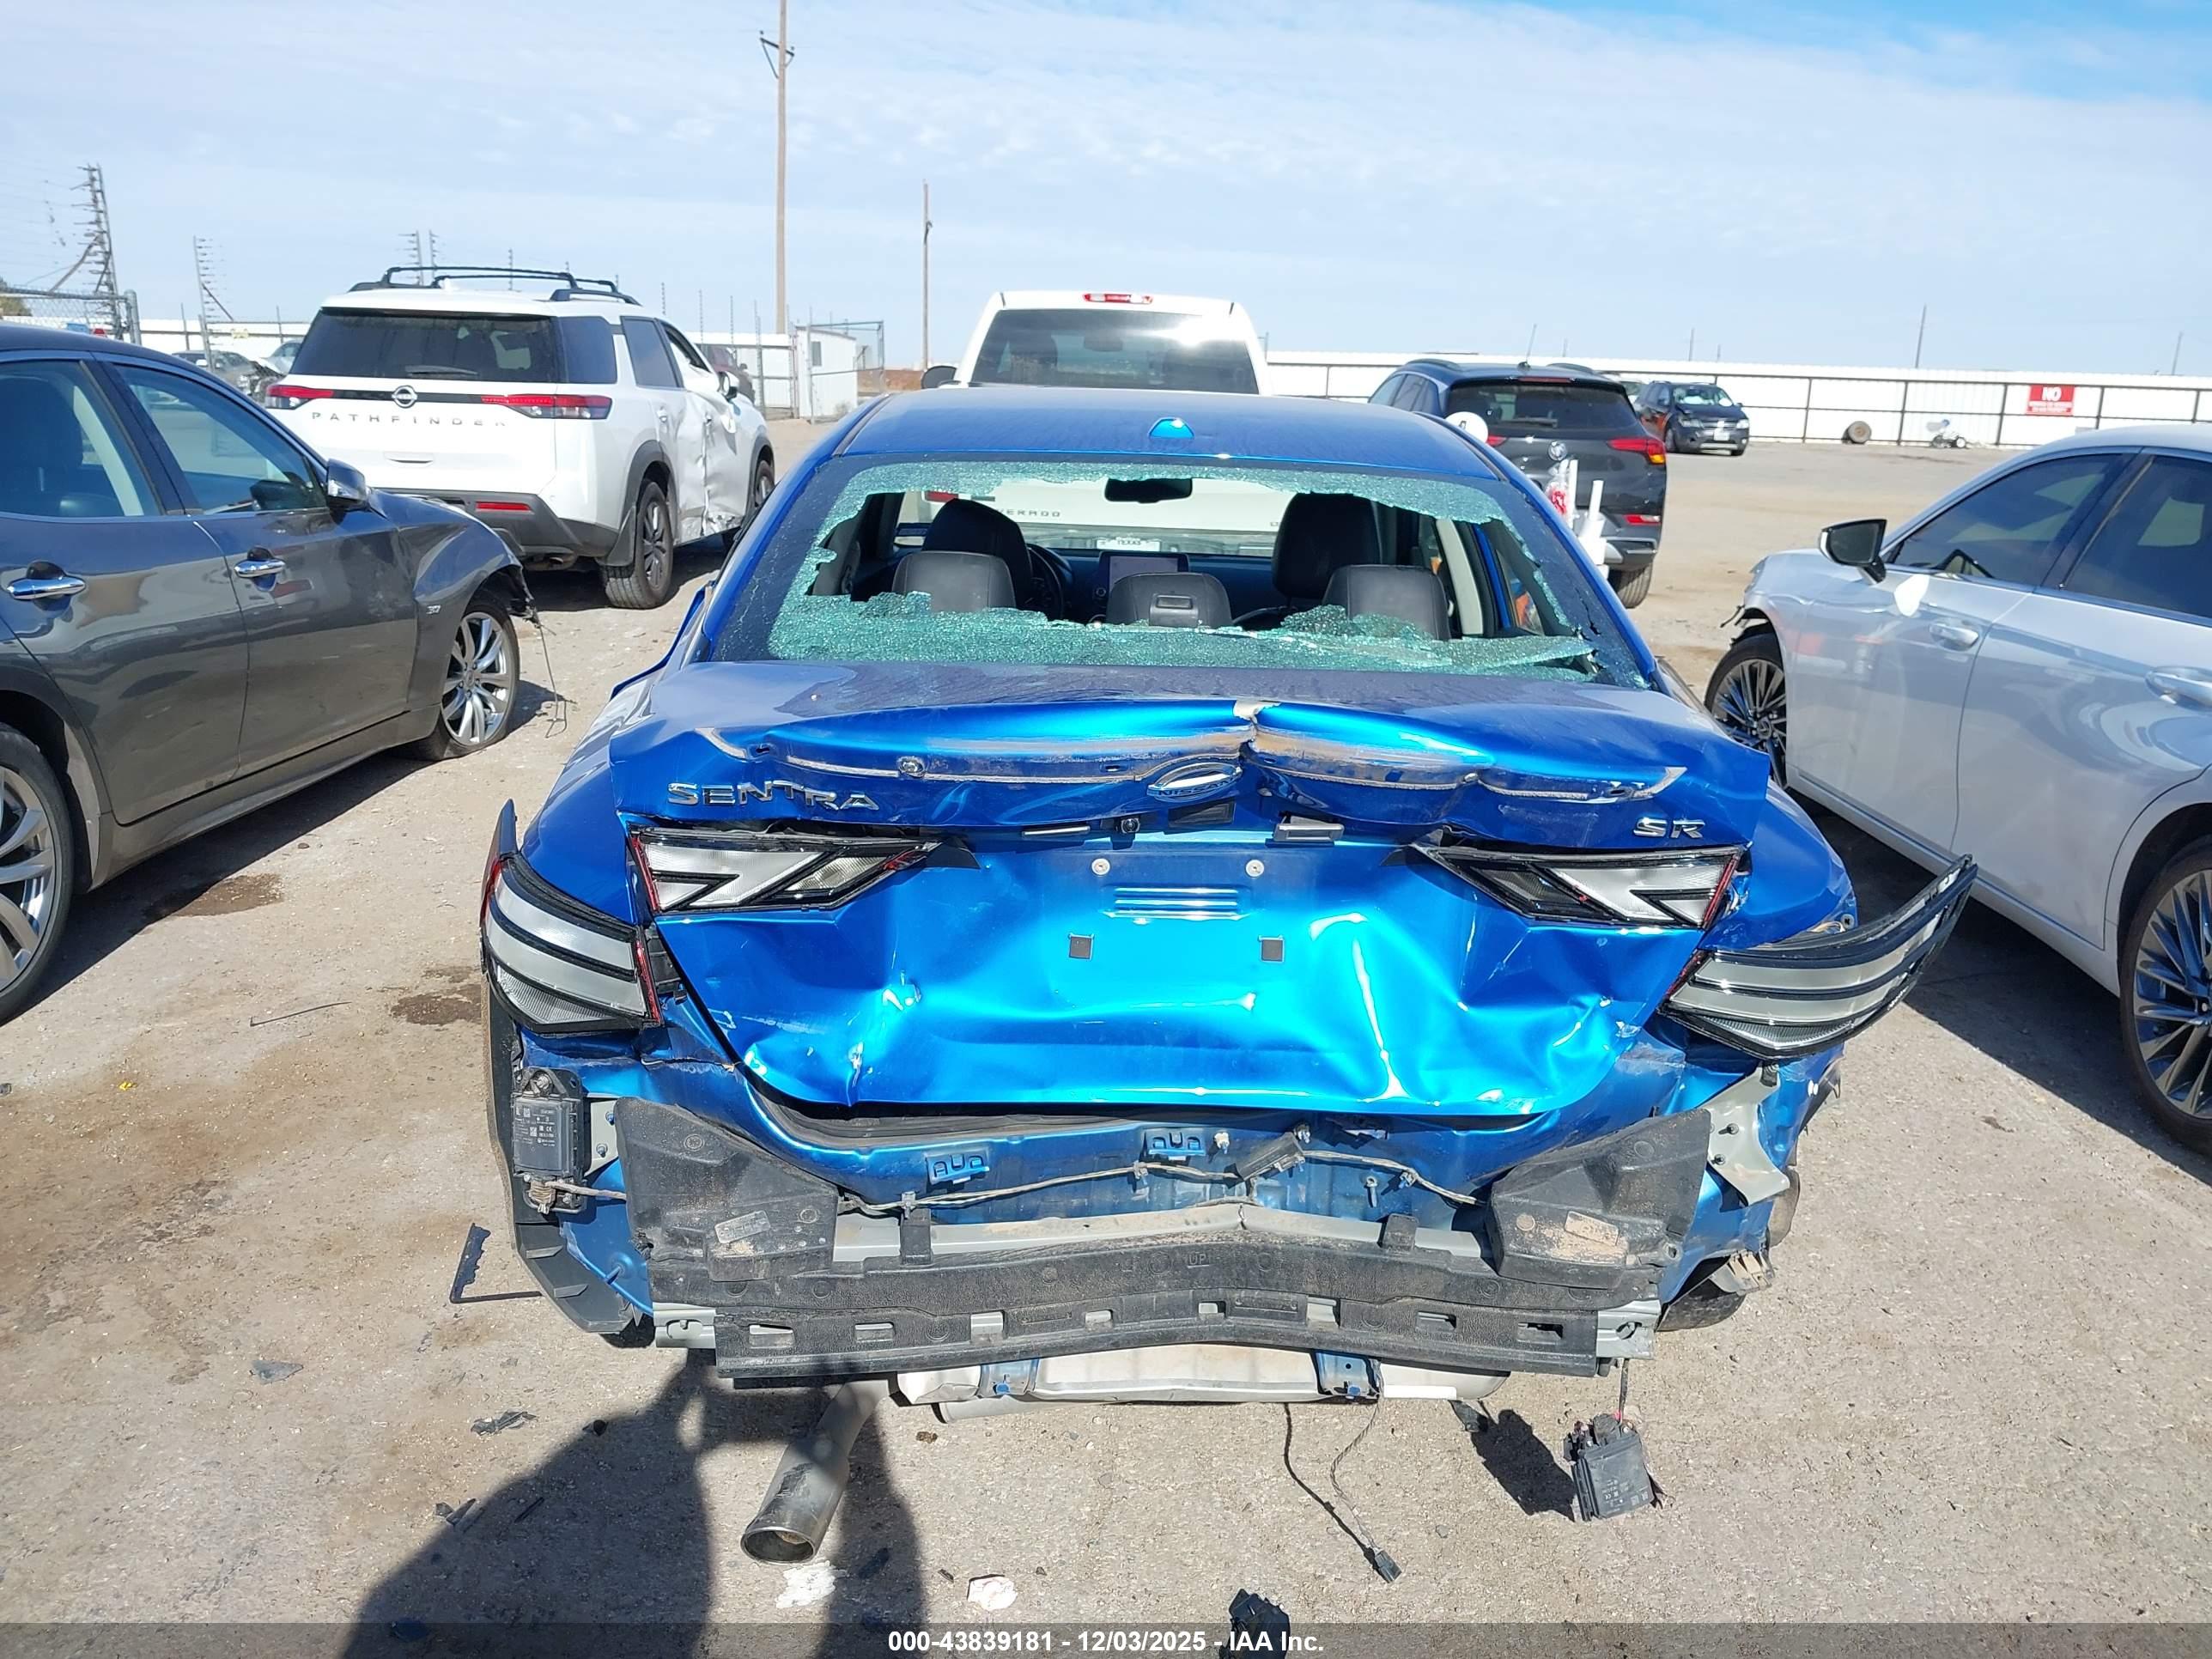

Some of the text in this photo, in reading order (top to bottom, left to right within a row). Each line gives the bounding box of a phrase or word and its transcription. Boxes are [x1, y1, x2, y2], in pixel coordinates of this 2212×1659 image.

[2042, 386, 2062, 401] NO
[668, 780, 879, 811] SENTRA
[1158, 775, 1236, 796] NISSAN
[1633, 817, 1705, 838] SR
[1188, 1253, 1207, 1266] UP
